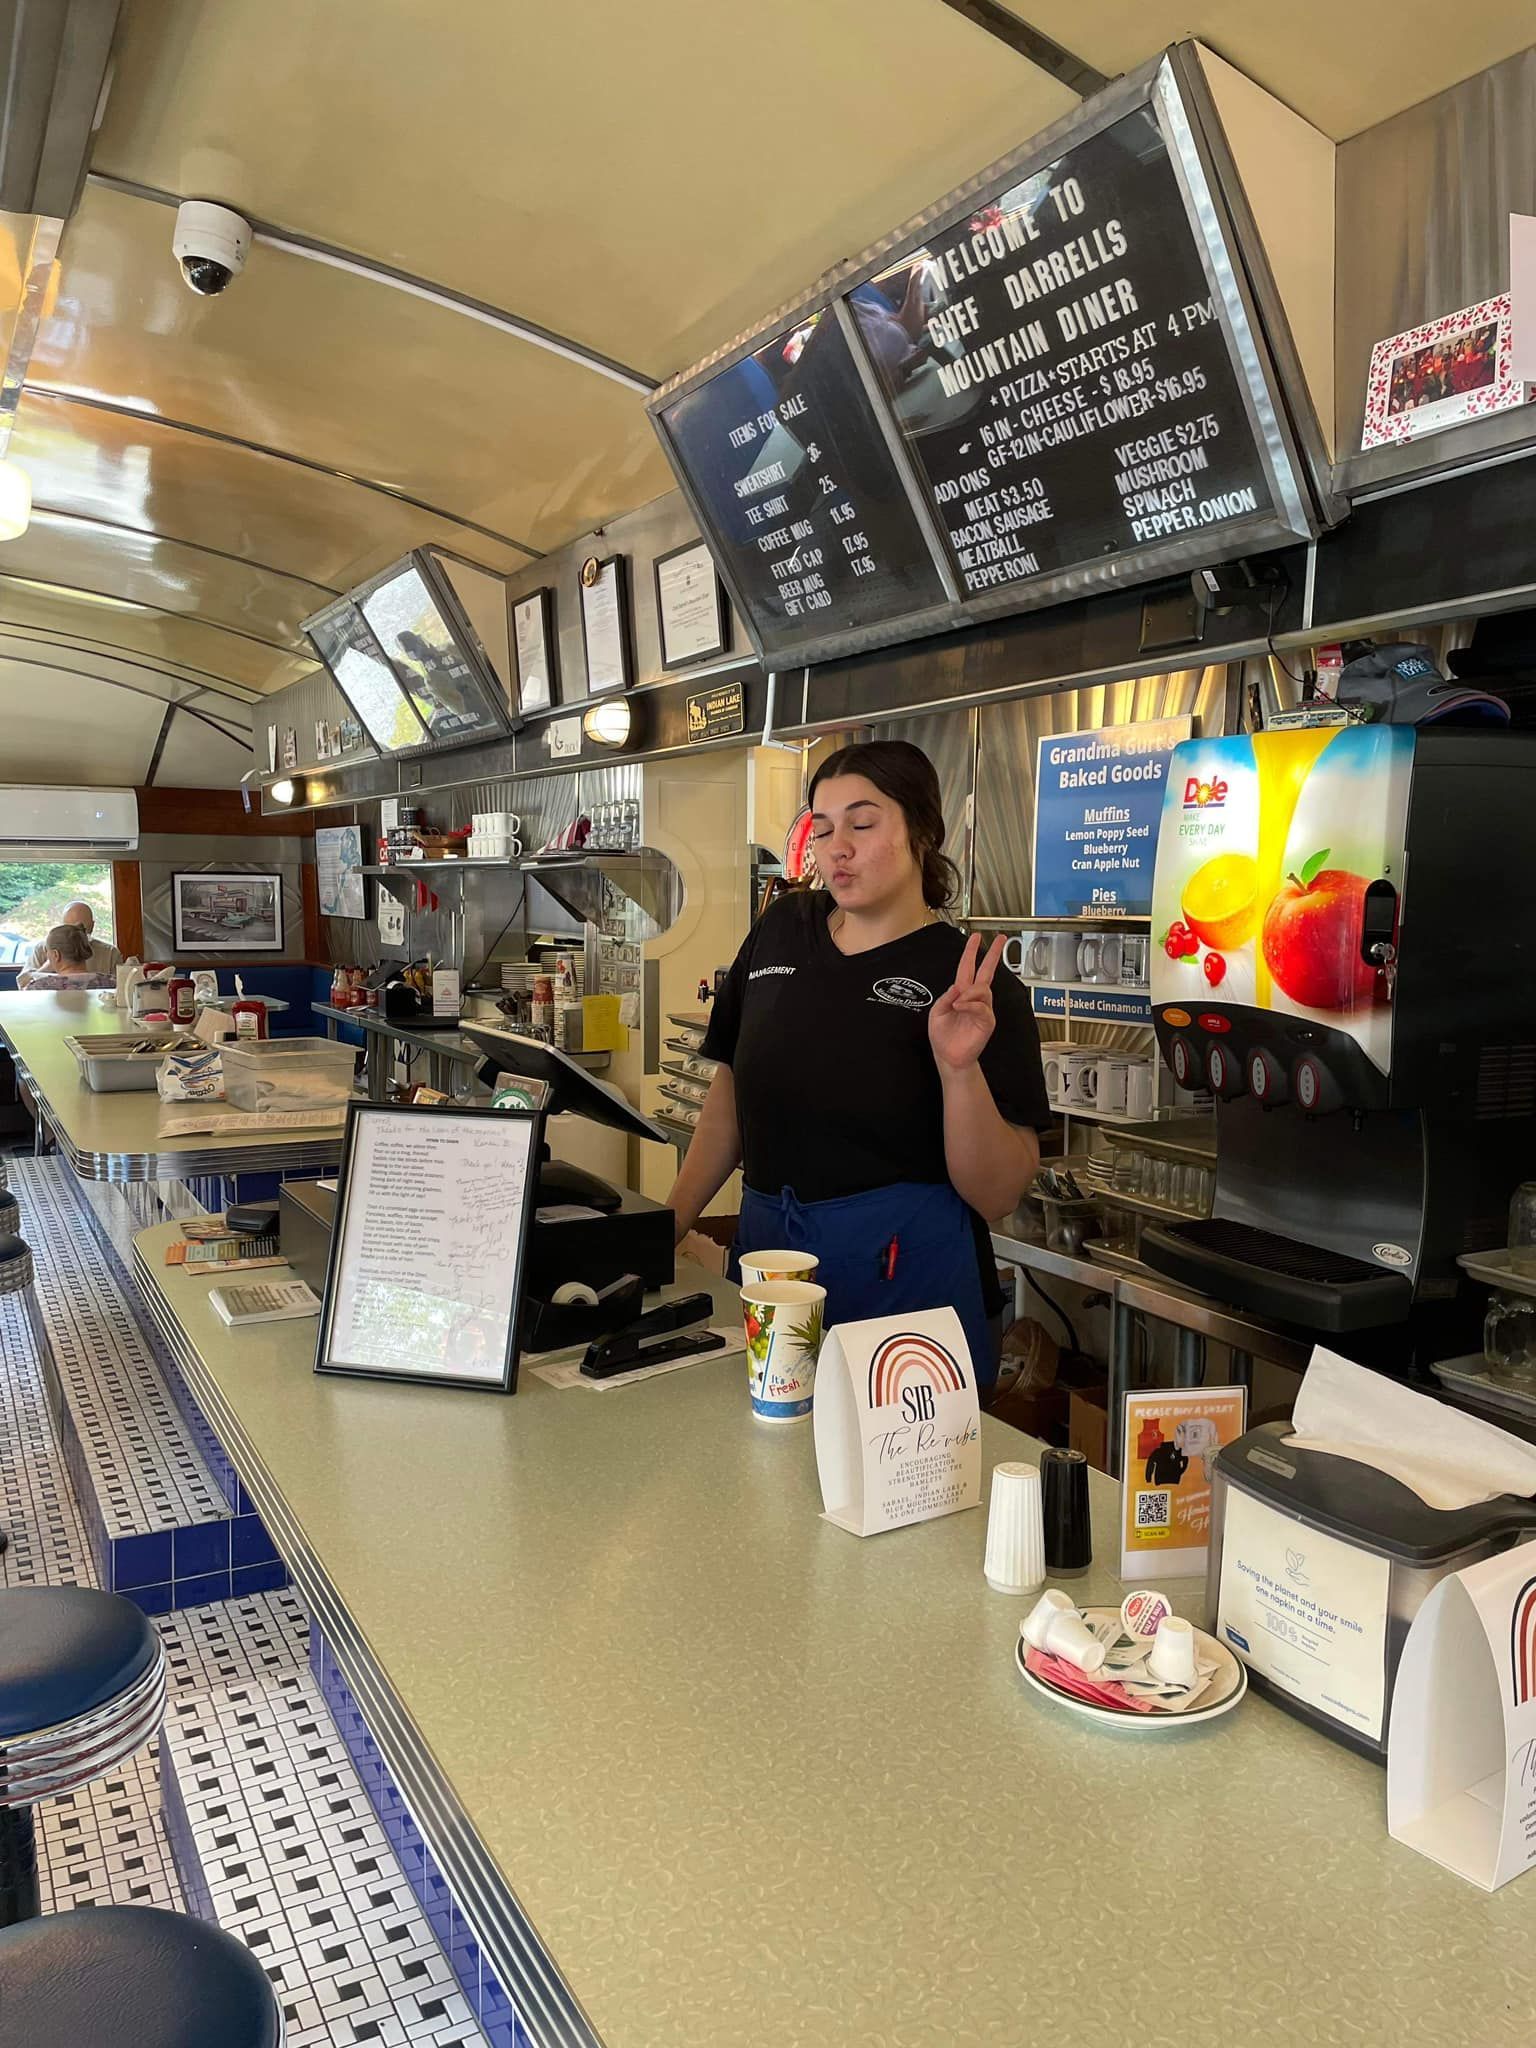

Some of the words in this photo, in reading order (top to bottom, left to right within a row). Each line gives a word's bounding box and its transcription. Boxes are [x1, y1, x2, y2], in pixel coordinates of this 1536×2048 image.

[929, 214, 1041, 292] WELCOME
[1049, 176, 1087, 223] TO
[927, 296, 981, 349] CHEF
[1004, 219, 1128, 310] DARRELLS
[936, 320, 1050, 398] MOUNTAIN
[1055, 277, 1140, 342] DINER
[999, 369, 1051, 408] PIZZA
[1055, 336, 1131, 387] STARTS
[1131, 322, 1158, 353] AT
[1167, 313, 1179, 337] 4
[1181, 297, 1219, 333] PM
[979, 426, 995, 447] 16
[1020, 386, 1088, 429] CHEESE
[1114, 357, 1157, 392] 18.95
[729, 422, 757, 448] ITEMS
[758, 411, 780, 434] FOR
[781, 394, 808, 422] SALE
[1114, 428, 1178, 469] VEGGIE
[1175, 414, 1221, 447] $2.75
[733, 461, 787, 498] SWEATSHIRT
[933, 479, 959, 504] ADD
[959, 468, 991, 497] ONS
[1114, 446, 1209, 496] MUSHROOM
[745, 504, 765, 526] TEE
[763, 495, 790, 520] SHIRT
[963, 493, 1001, 522] MEAT
[1001, 477, 1045, 508] $3.50
[1122, 477, 1197, 519] SPINACH
[757, 529, 792, 553] COFFEE
[791, 519, 814, 543] MUG
[802, 549, 824, 572] CAP
[842, 532, 870, 555] 17.95
[957, 534, 1025, 570] MEATBALL
[778, 579, 802, 600] BEER
[801, 573, 825, 596] MUG
[964, 553, 1040, 591] PEPPERONI
[784, 596, 805, 617] GIFT
[805, 591, 833, 613] CARD
[1049, 741, 1121, 766] Grandma
[1059, 765, 1107, 789] Baked
[1111, 760, 1163, 784] Goods
[1183, 776, 1229, 803] Dole
[1084, 806, 1131, 824] Muffins
[1179, 824, 1206, 836] EVERY
[1207, 824, 1226, 835] DAY
[1065, 829, 1095, 841] Lemon
[1096, 828, 1125, 842] Poppy
[1126, 825, 1150, 838] Seed
[1083, 843, 1129, 857] Blueberry
[1071, 859, 1093, 870] Cran
[1094, 858, 1121, 872] Apple
[1121, 857, 1141, 869] Nut
[1081, 905, 1128, 916] Blueberry
[1091, 887, 1118, 903] Pies
[748, 966, 797, 981] MANAGEMENT
[1043, 996, 1066, 1007] Fresh
[1069, 998, 1095, 1011] Baked
[1096, 999, 1143, 1015] Cinnamon
[769, 1378, 800, 1397] Fresh
[771, 1374, 785, 1385] It's
[901, 1384, 936, 1424] SIB
[869, 1426, 912, 1464] The
[1235, 1560, 1261, 1582] Saving
[1261, 1574, 1274, 1589] the
[1274, 1583, 1299, 1603] planet
[1300, 1596, 1317, 1611] and
[1318, 1607, 1340, 1623] your
[1339, 1617, 1364, 1634] smile
[1255, 1585, 1270, 1598] one
[1270, 1593, 1296, 1615] napkin
[1296, 1607, 1307, 1619] at
[1315, 1617, 1336, 1634] time.
